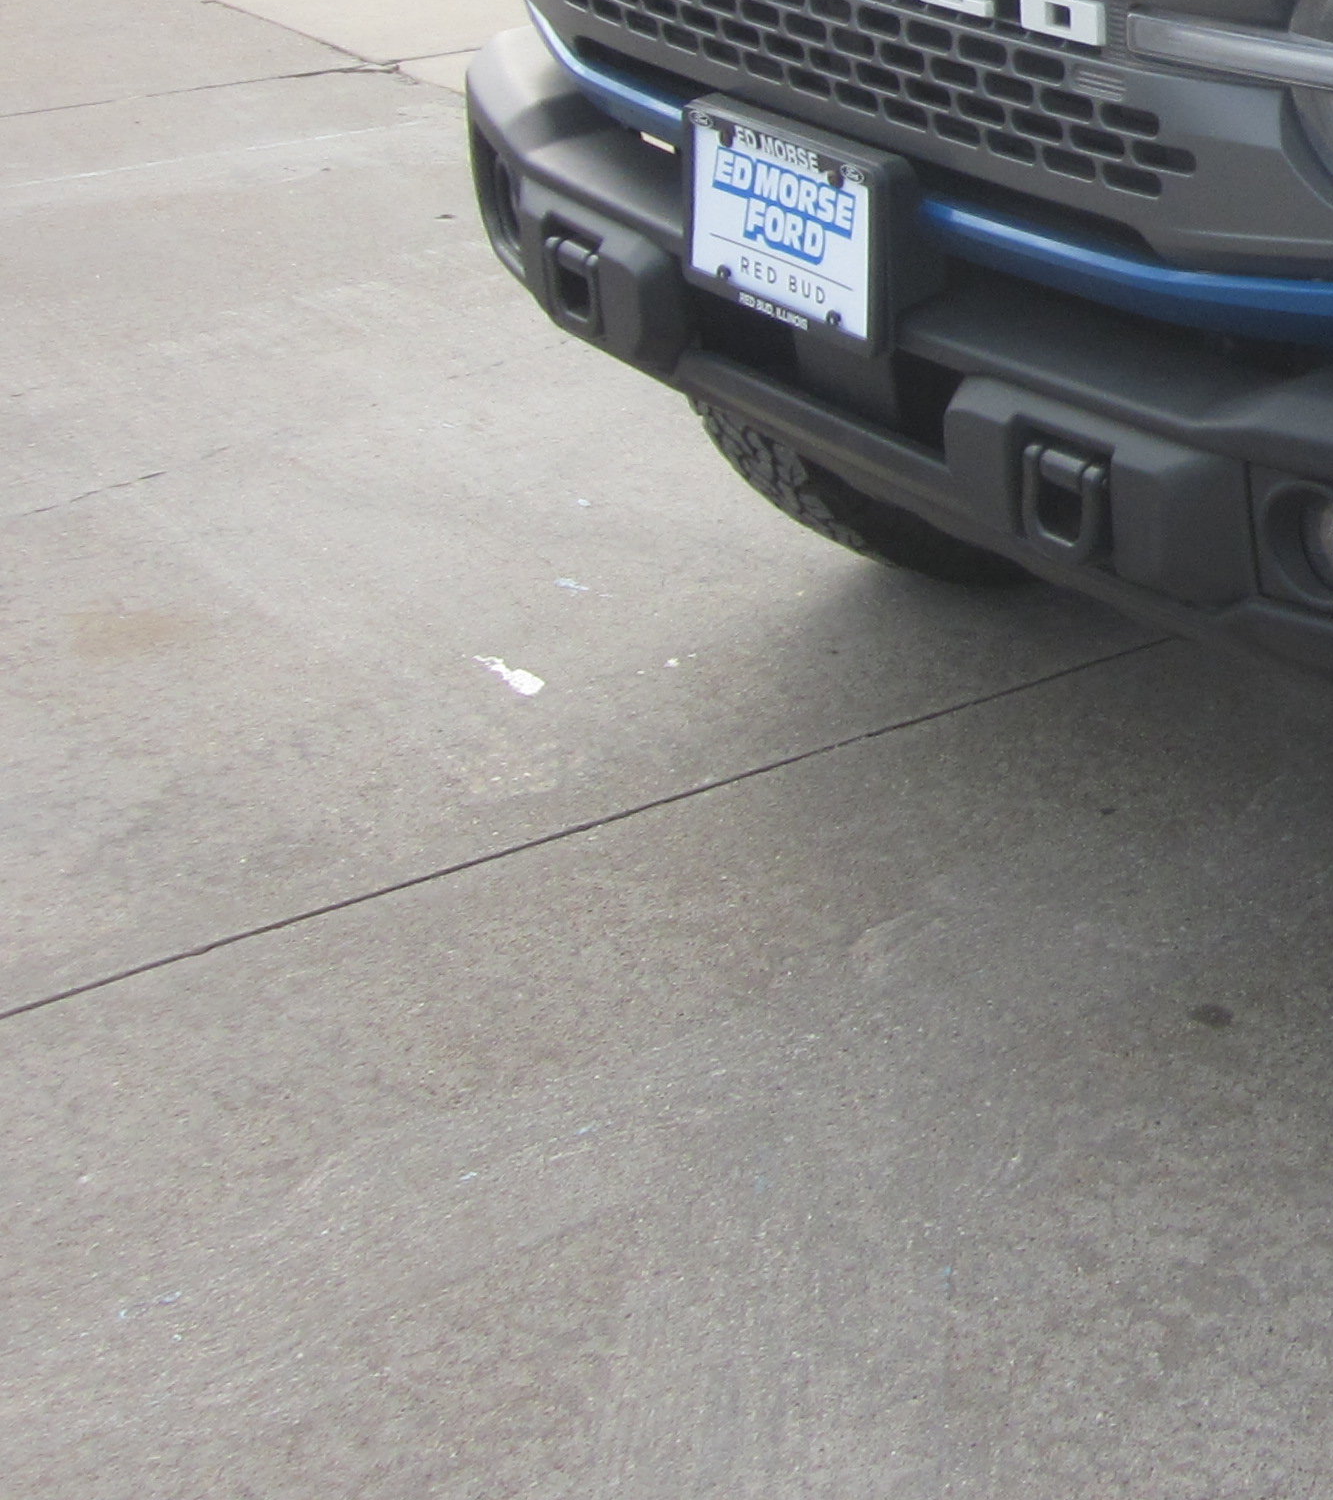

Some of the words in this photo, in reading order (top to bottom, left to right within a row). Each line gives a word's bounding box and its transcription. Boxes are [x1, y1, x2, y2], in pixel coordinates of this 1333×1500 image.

[734, 125, 757, 149] ED
[759, 134, 819, 173] MORSE
[714, 150, 753, 192] ED
[753, 161, 854, 232] MORSE
[744, 199, 825, 259] FORD
[740, 256, 778, 284] RED
[788, 275, 826, 305] BUD
